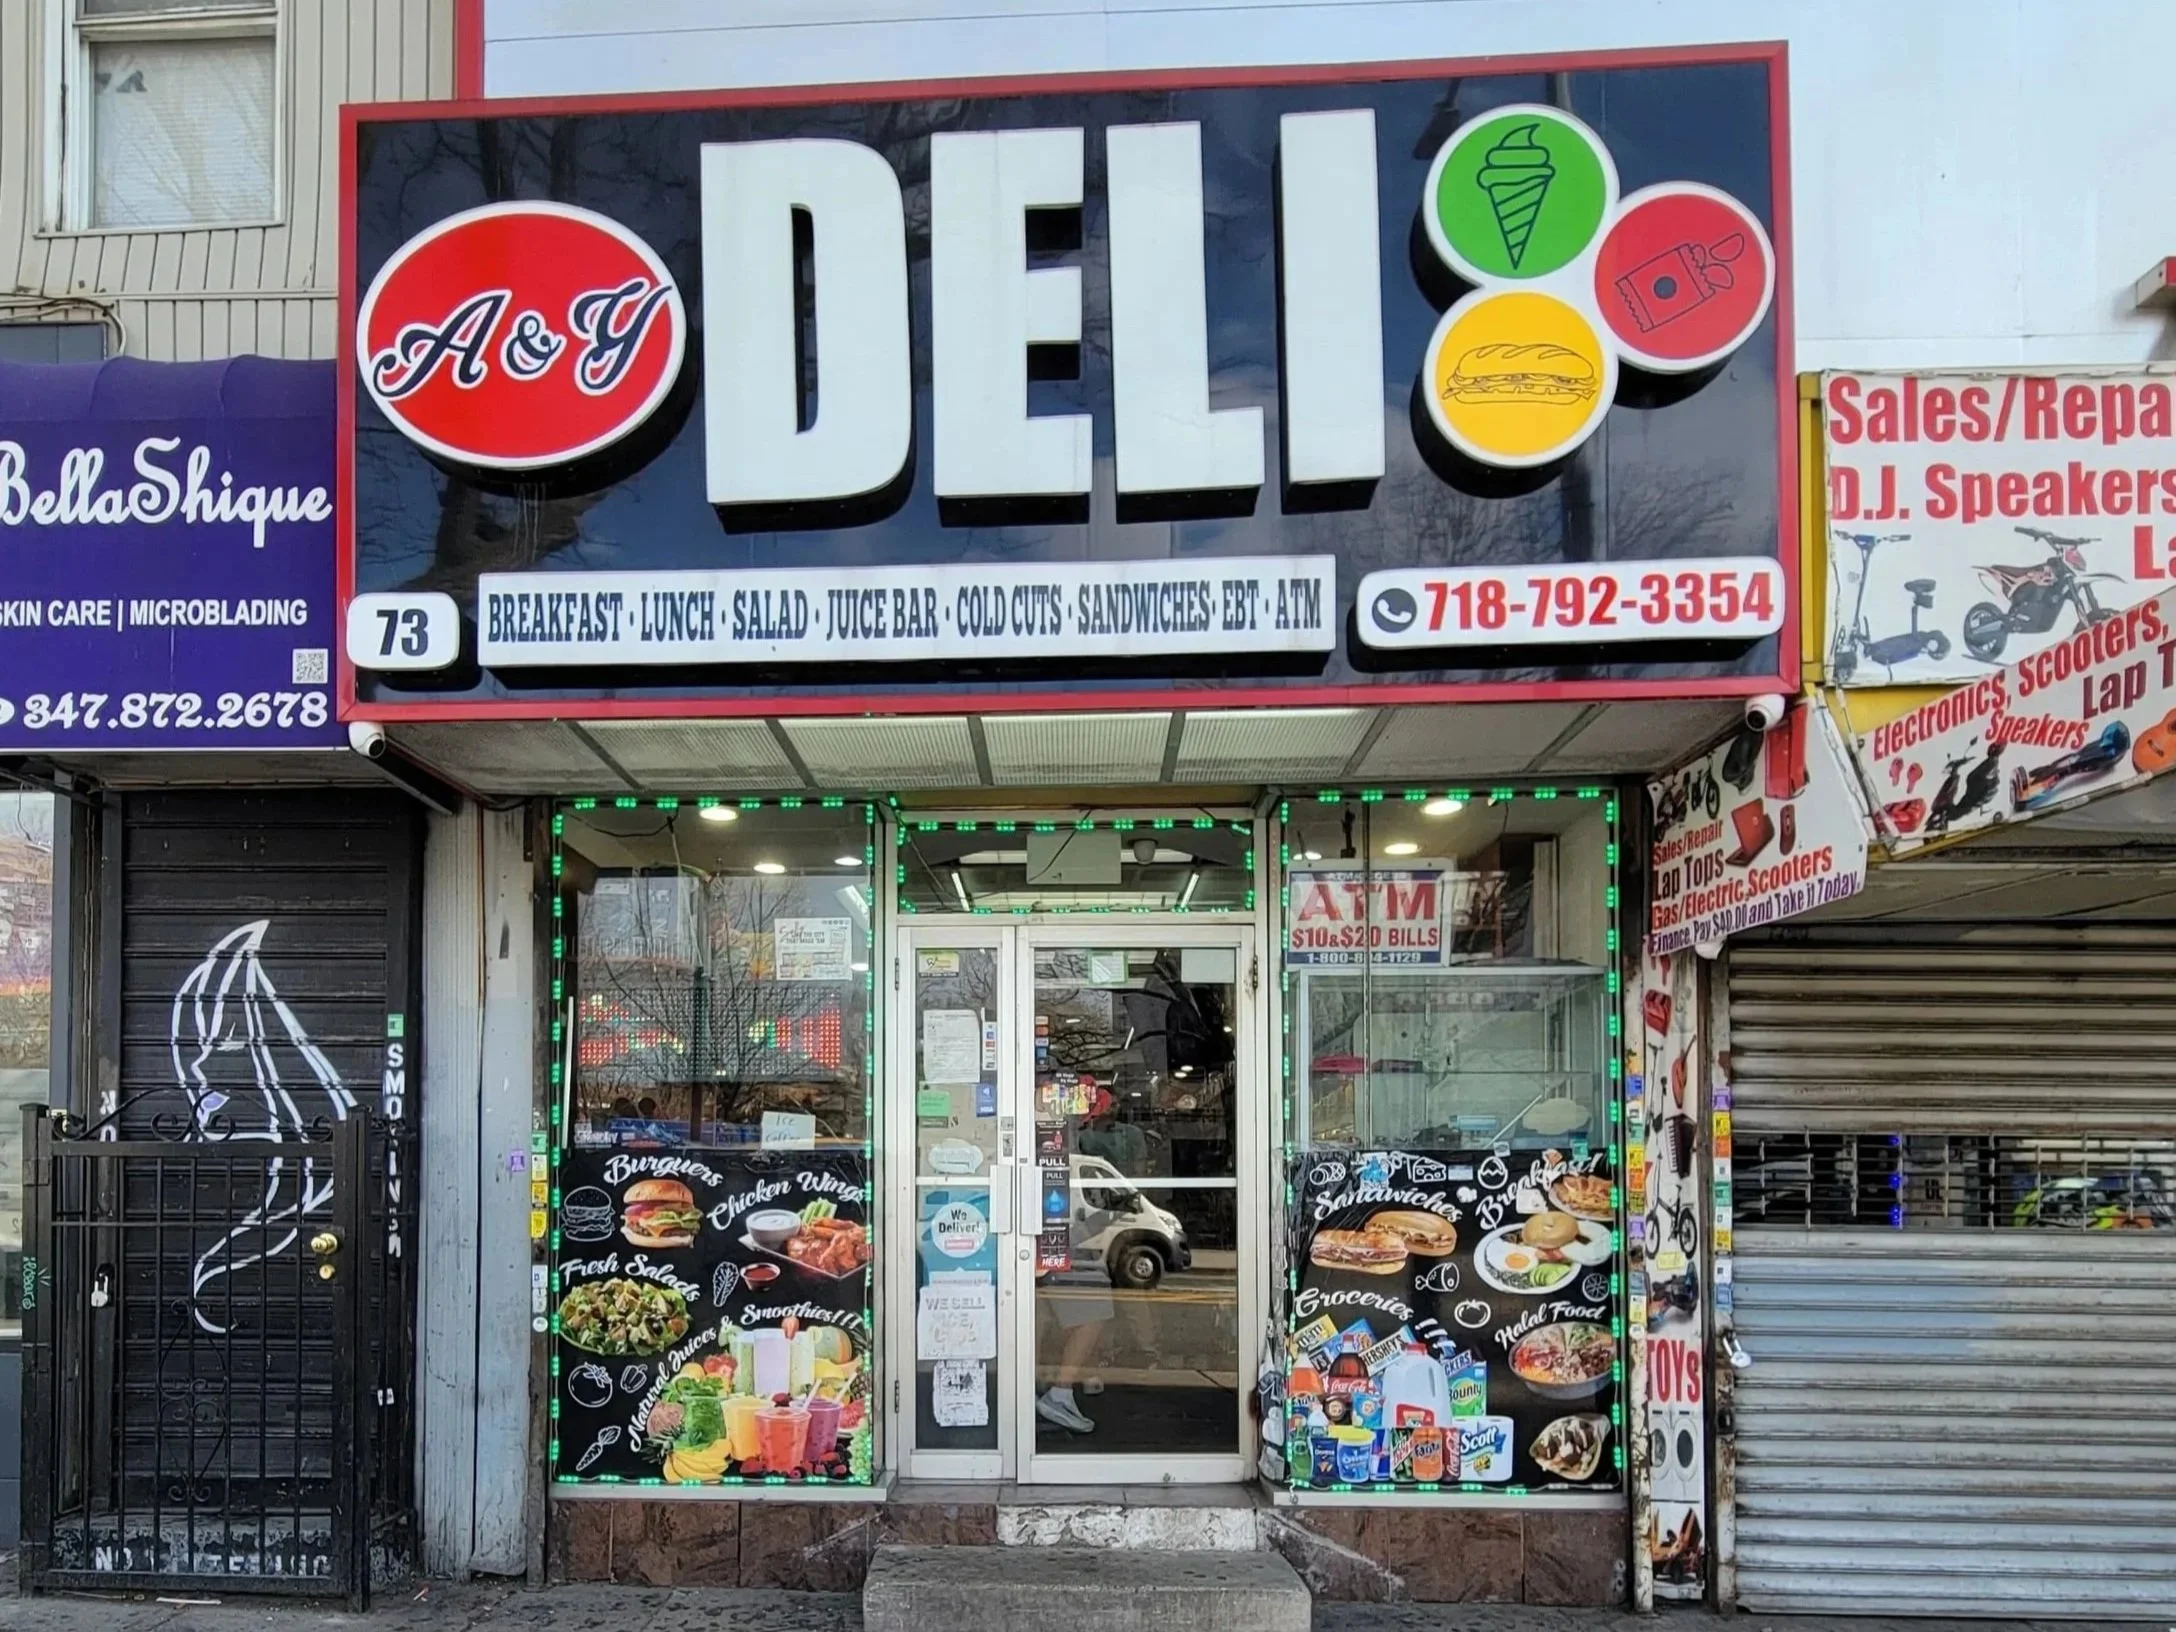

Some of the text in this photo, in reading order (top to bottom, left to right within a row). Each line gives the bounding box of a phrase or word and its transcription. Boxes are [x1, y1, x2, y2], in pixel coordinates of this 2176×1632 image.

[701, 108, 1386, 505] DELI
[1828, 376, 2172, 445] Sales/Repa
[0, 437, 332, 547] BellaShique
[1830, 461, 2176, 523] D.J. Speakers
[48, 600, 111, 627] CARE
[129, 599, 307, 627] MICROBLADING
[487, 578, 1321, 643] BREAKFAST LUNCH SALAD JUICE BAR COLD CUTS SANDWICHES EBT ATM
[1424, 572, 1774, 631] 718-792-3354
[376, 609, 429, 656] 73
[1872, 599, 2169, 762] Electronics, Scooters,
[2083, 661, 2147, 720] Lap
[23, 691, 329, 730] 347.872.2678
[1984, 709, 2090, 750] Speakers
[1653, 820, 1723, 866] Sales/Repair
[1653, 849, 1724, 902] Lap Tops
[1748, 845, 1833, 897] Scooters
[1297, 883, 1437, 921] ATM
[1748, 896, 1773, 925] and
[1774, 887, 1804, 917] Take
[1388, 927, 1438, 947] BILLS
[603, 1153, 724, 1189] Burguers
[1038, 1158, 1066, 1167] PULL
[706, 1171, 867, 1232] Chicken Wings
[1313, 1184, 1464, 1222] Sandwiches
[559, 1252, 701, 1303] Fresh Salads
[1041, 1258, 1066, 1267] HERE
[1294, 1288, 1414, 1321] Groceries
[1495, 1302, 1607, 1348] Halal Food
[627, 1361, 672, 1452] Natural
[668, 1325, 717, 1372] Juices
[1460, 1425, 1500, 1453] Scott
